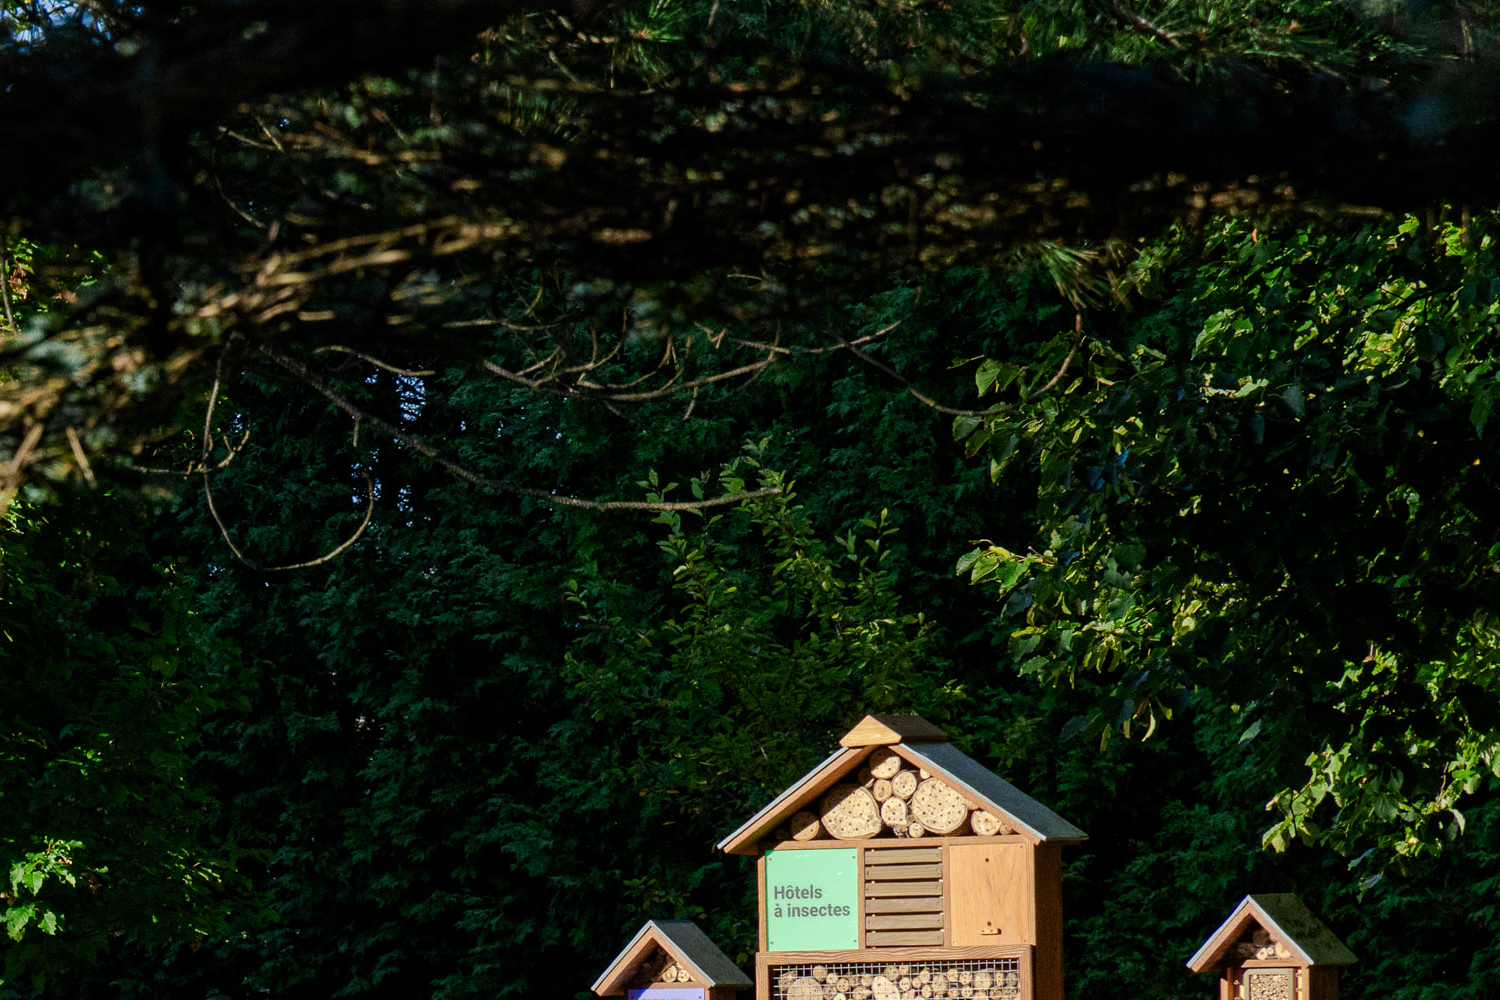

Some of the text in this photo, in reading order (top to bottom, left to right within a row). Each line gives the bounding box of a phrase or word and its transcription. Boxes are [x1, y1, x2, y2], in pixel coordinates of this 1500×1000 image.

[774, 884, 822, 899] Hôtels
[774, 903, 850, 917] à insectes
